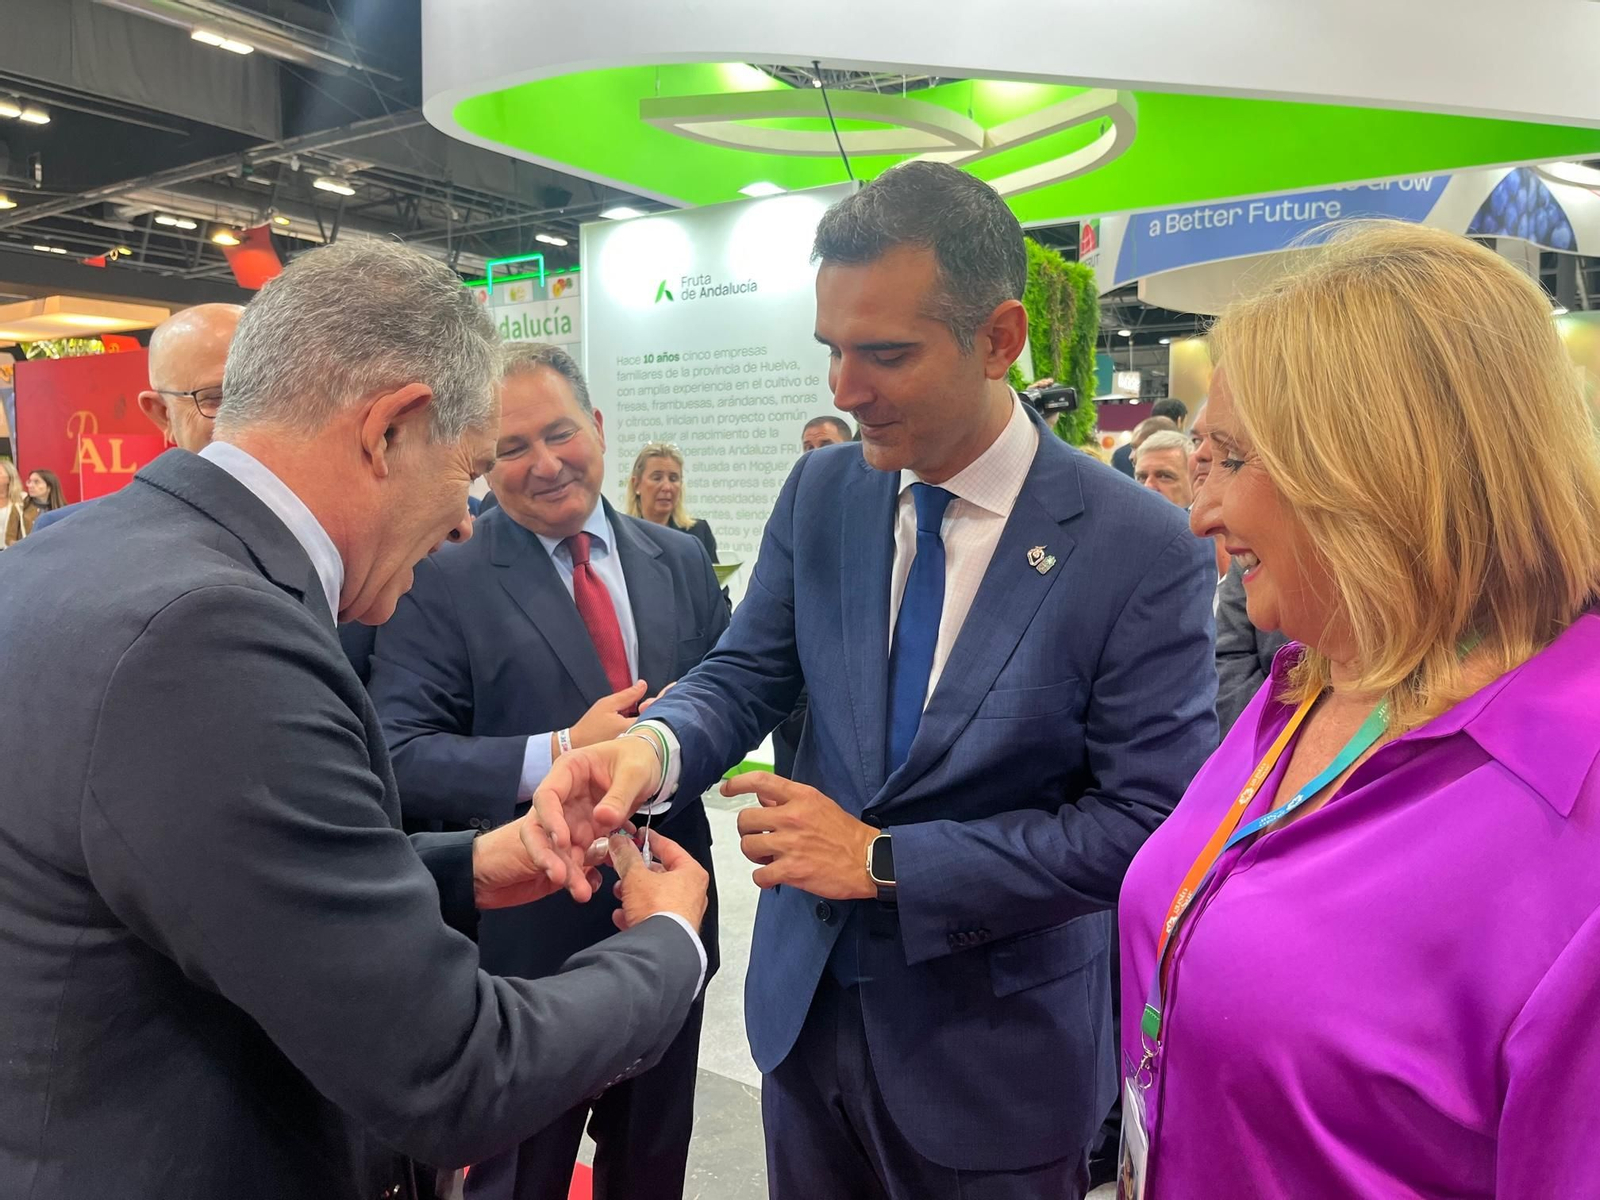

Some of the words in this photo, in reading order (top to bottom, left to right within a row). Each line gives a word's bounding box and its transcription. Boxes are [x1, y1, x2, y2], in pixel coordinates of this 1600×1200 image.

[1149, 219, 1161, 237] a
[1166, 207, 1242, 235] Better
[1249, 200, 1341, 224] Future
[681, 274, 711, 287] Fruta
[681, 289, 696, 300] de
[699, 278, 758, 298] Andalucía
[498, 306, 572, 339] dalucía
[617, 356, 641, 366] Hace
[643, 354, 654, 364] 10
[656, 351, 680, 363] años
[682, 350, 711, 361] cinco
[713, 346, 767, 360] empresas
[617, 369, 663, 381] familiares
[665, 368, 679, 378] de
[682, 366, 690, 377] la
[693, 363, 740, 378] provincia
[743, 362, 757, 373] de
[617, 387, 635, 397] con
[637, 384, 671, 397] amplia
[673, 381, 732, 395] experiencia
[735, 381, 749, 391] en
[752, 378, 762, 389] el
[764, 376, 802, 388] cultivo
[804, 375, 819, 386] de
[781, 393, 818, 404] moras
[666, 414, 698, 426] inician
[701, 414, 715, 425] un
[717, 412, 765, 426] proyecto
[768, 408, 807, 422] común
[691, 428, 749, 440] nacimiento
[752, 427, 767, 438] de
[769, 427, 779, 438] la
[728, 444, 777, 456] Andaluza
[781, 444, 801, 454] FRU
[691, 461, 730, 473] situada
[733, 461, 747, 471] en
[712, 476, 760, 490] empresa
